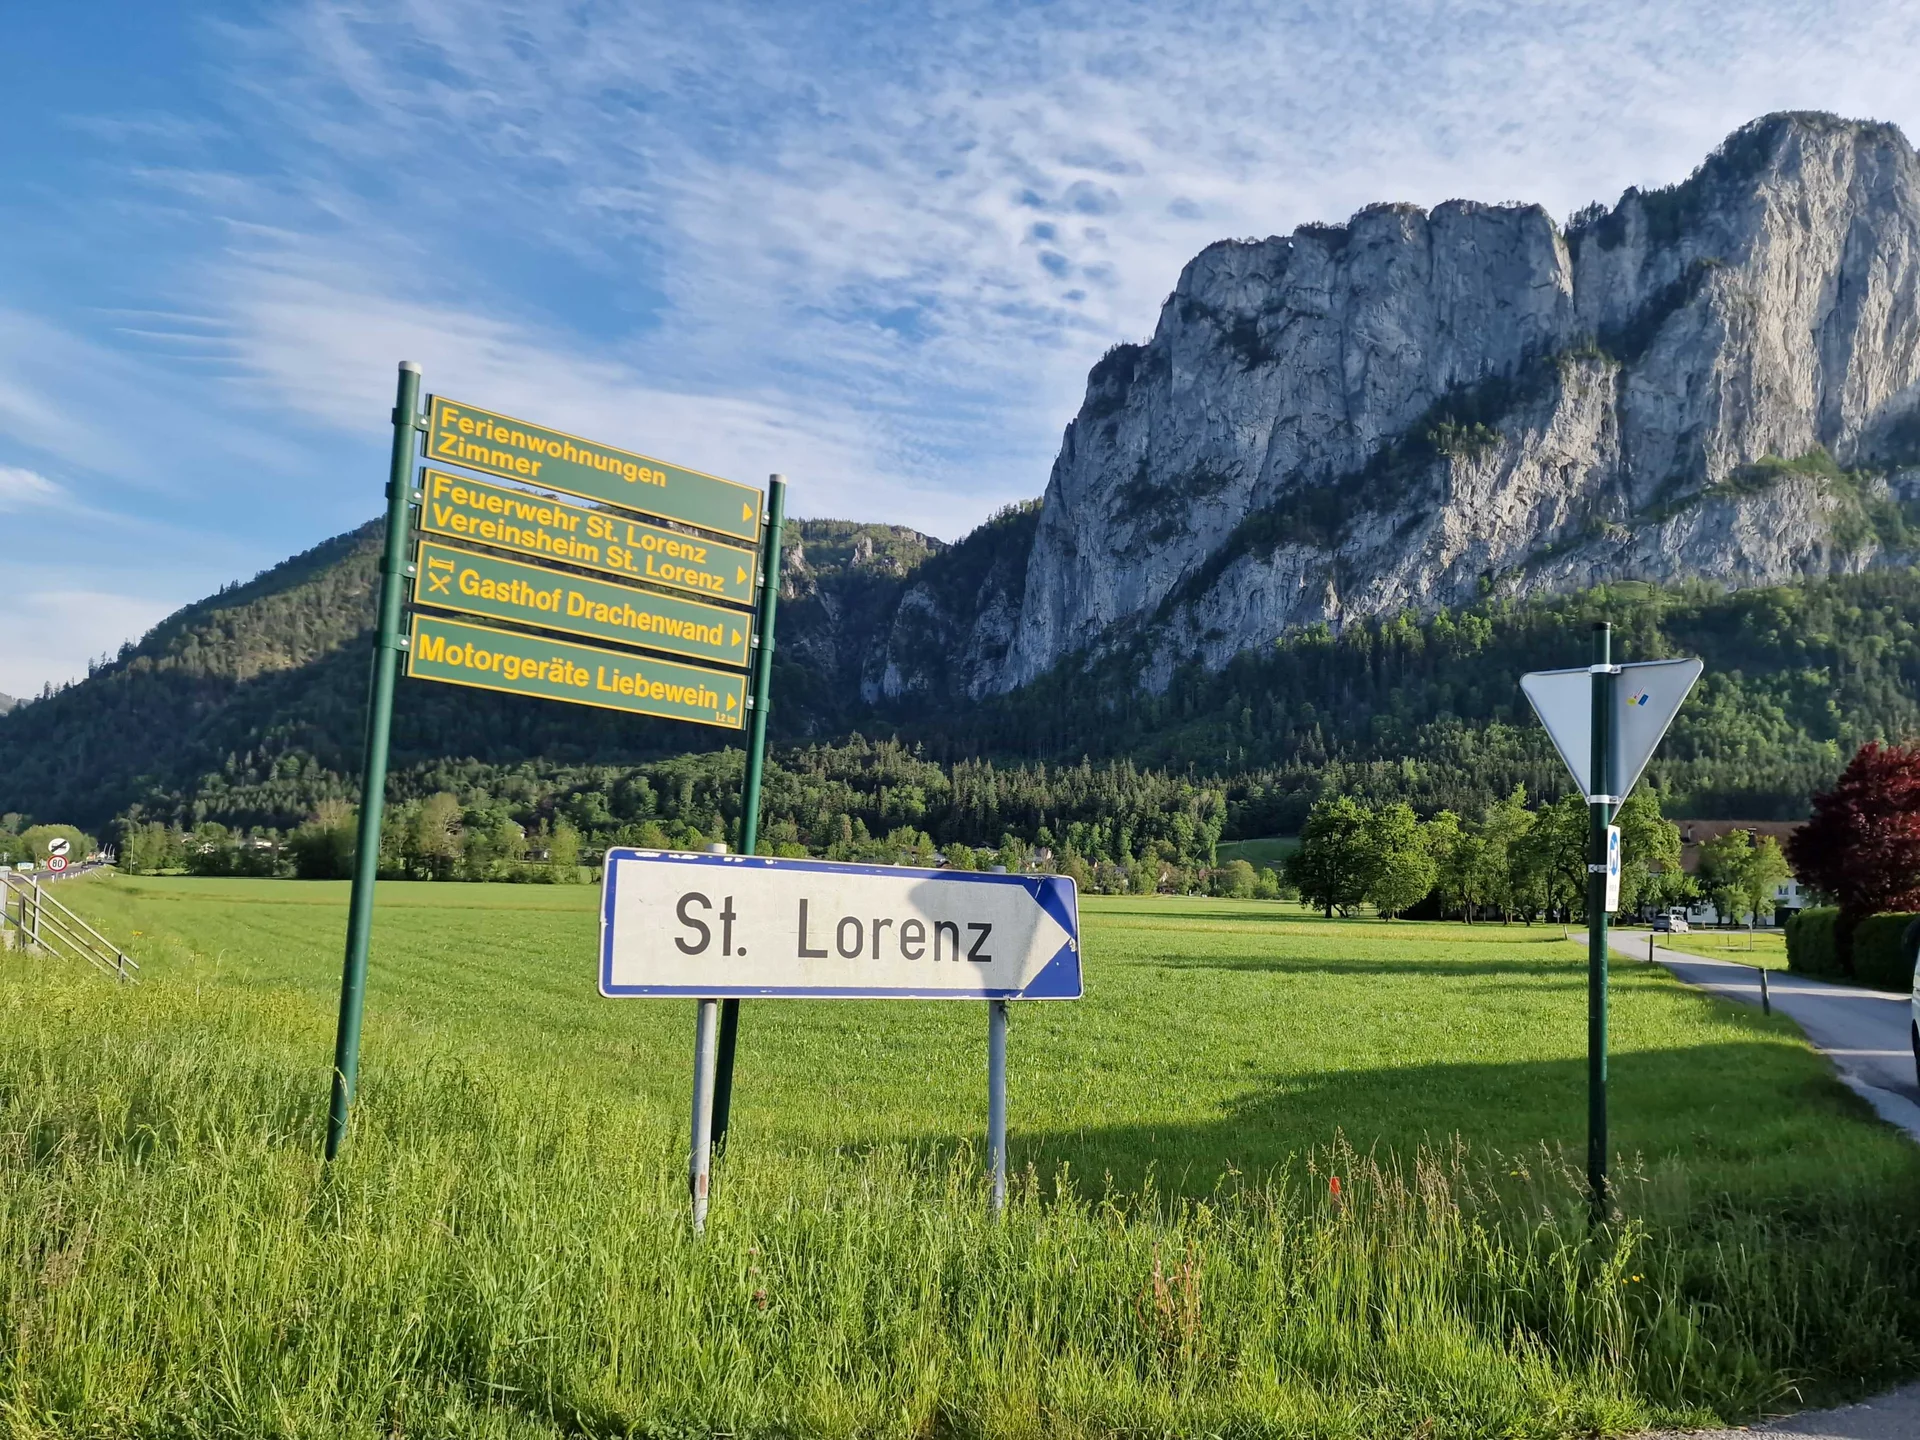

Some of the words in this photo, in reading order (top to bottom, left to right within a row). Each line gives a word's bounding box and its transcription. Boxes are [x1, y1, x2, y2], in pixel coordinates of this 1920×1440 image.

[438, 432, 543, 477] Zimmer
[441, 407, 667, 488] Ferienwohnungen
[432, 477, 580, 532] Feuerwehr
[586, 514, 618, 542] St.
[626, 525, 707, 564] Lorenz
[433, 503, 600, 562] Vereinsheim
[606, 546, 639, 572] St.
[645, 555, 726, 593] Lorenz
[459, 568, 563, 612] Gasthof
[567, 590, 724, 647] Drachenwand
[418, 633, 591, 688] Motorgeräte
[596, 665, 719, 710] Liebewein
[674, 892, 748, 957] St.
[798, 898, 993, 963] Lorenz
